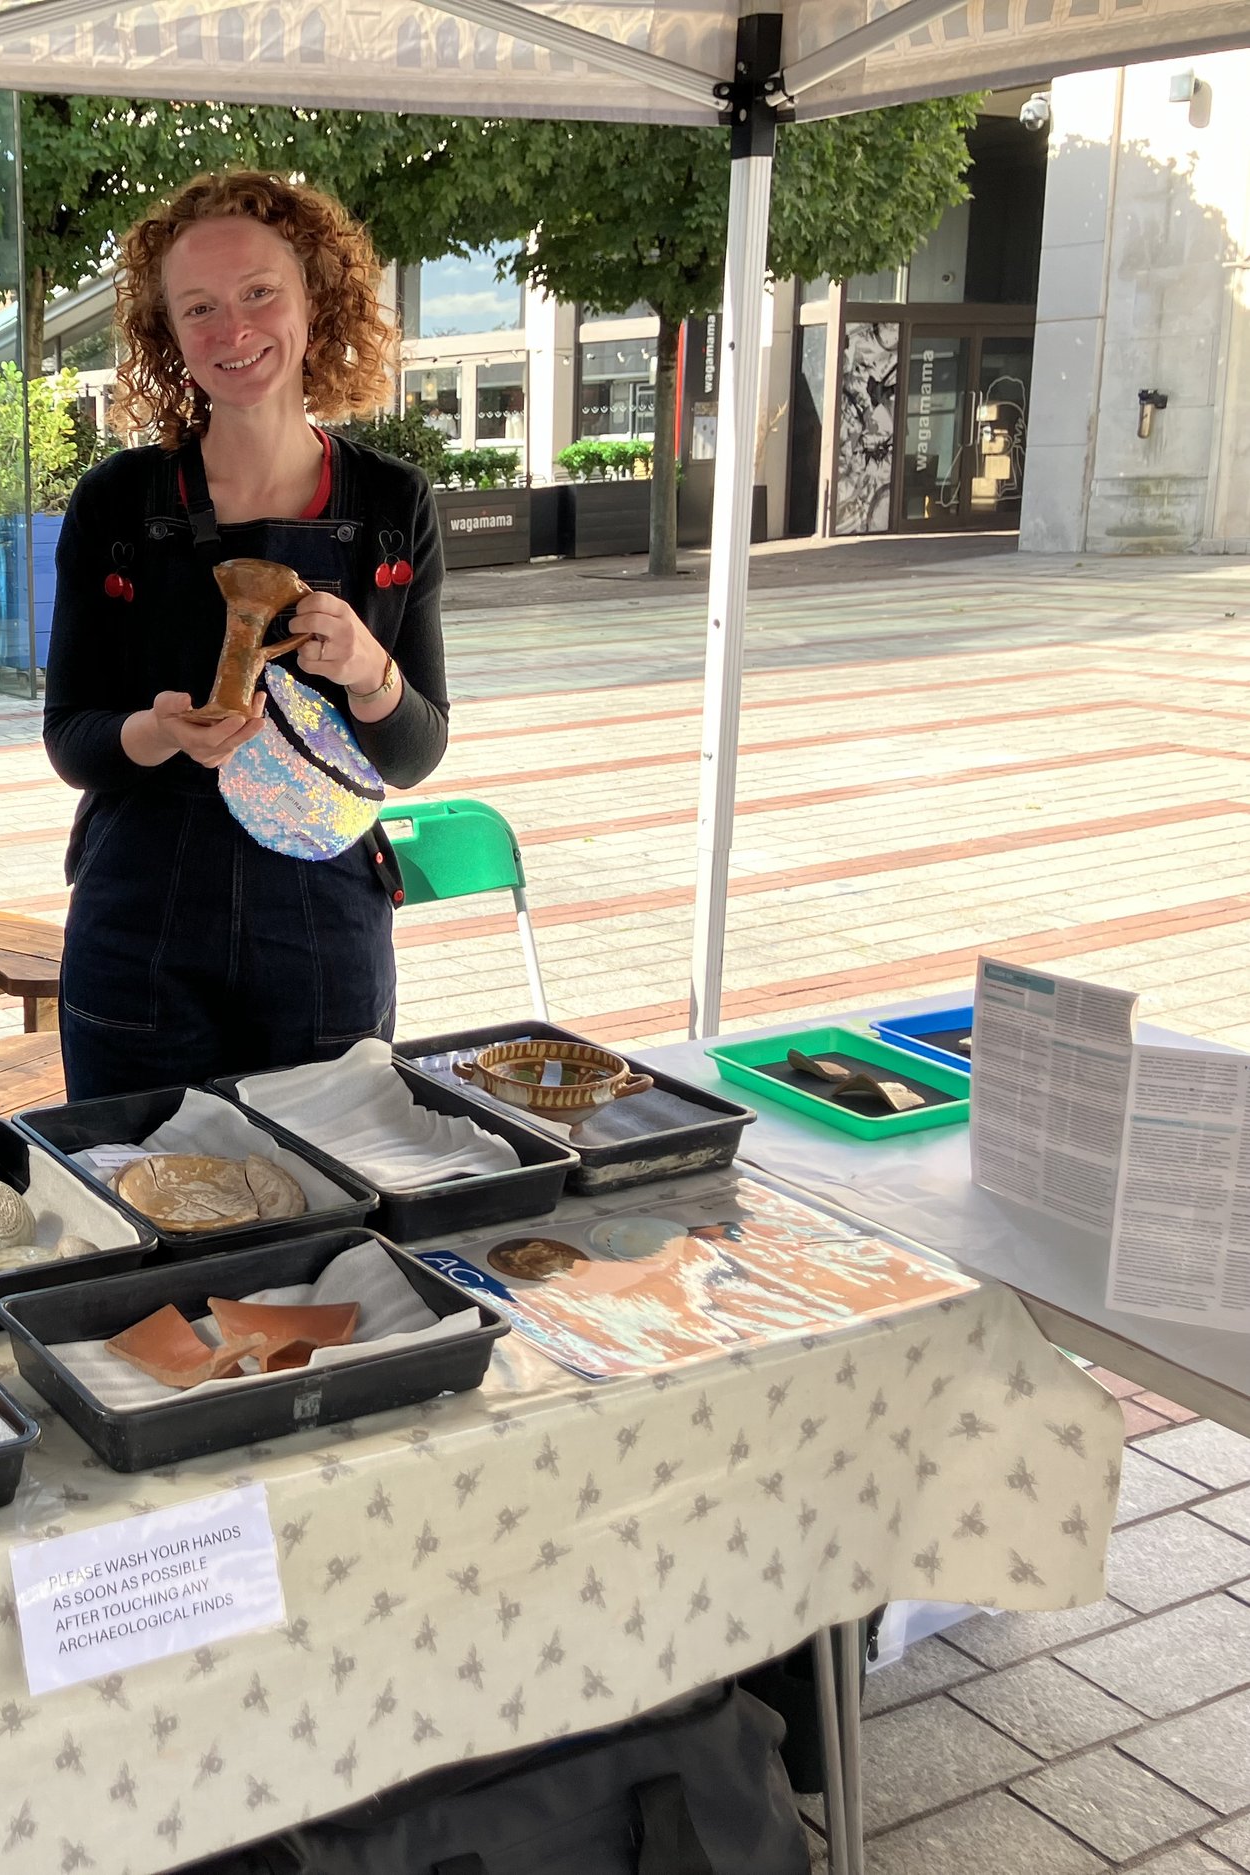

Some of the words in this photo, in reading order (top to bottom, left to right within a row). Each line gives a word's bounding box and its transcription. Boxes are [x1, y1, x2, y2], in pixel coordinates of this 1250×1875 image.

[704, 314, 716, 393] wagamama
[916, 350, 934, 471] wagamama
[450, 514, 513, 532] wagamama
[423, 1256, 484, 1284] AC
[49, 1563, 103, 1589] PLEASE
[104, 1550, 149, 1577] WASH
[150, 1539, 191, 1562] YOUR
[192, 1525, 242, 1550] HANDS
[53, 1595, 71, 1611] AS
[74, 1581, 117, 1606] SOON
[120, 1574, 139, 1591] AS
[142, 1556, 208, 1586] POSSIBLE
[55, 1609, 101, 1633] AFTER
[104, 1587, 179, 1619] TOUCHING
[182, 1577, 210, 1597] ANY
[58, 1606, 191, 1655] ARCHAEOLOGICAL
[192, 1592, 235, 1616] FINDS
